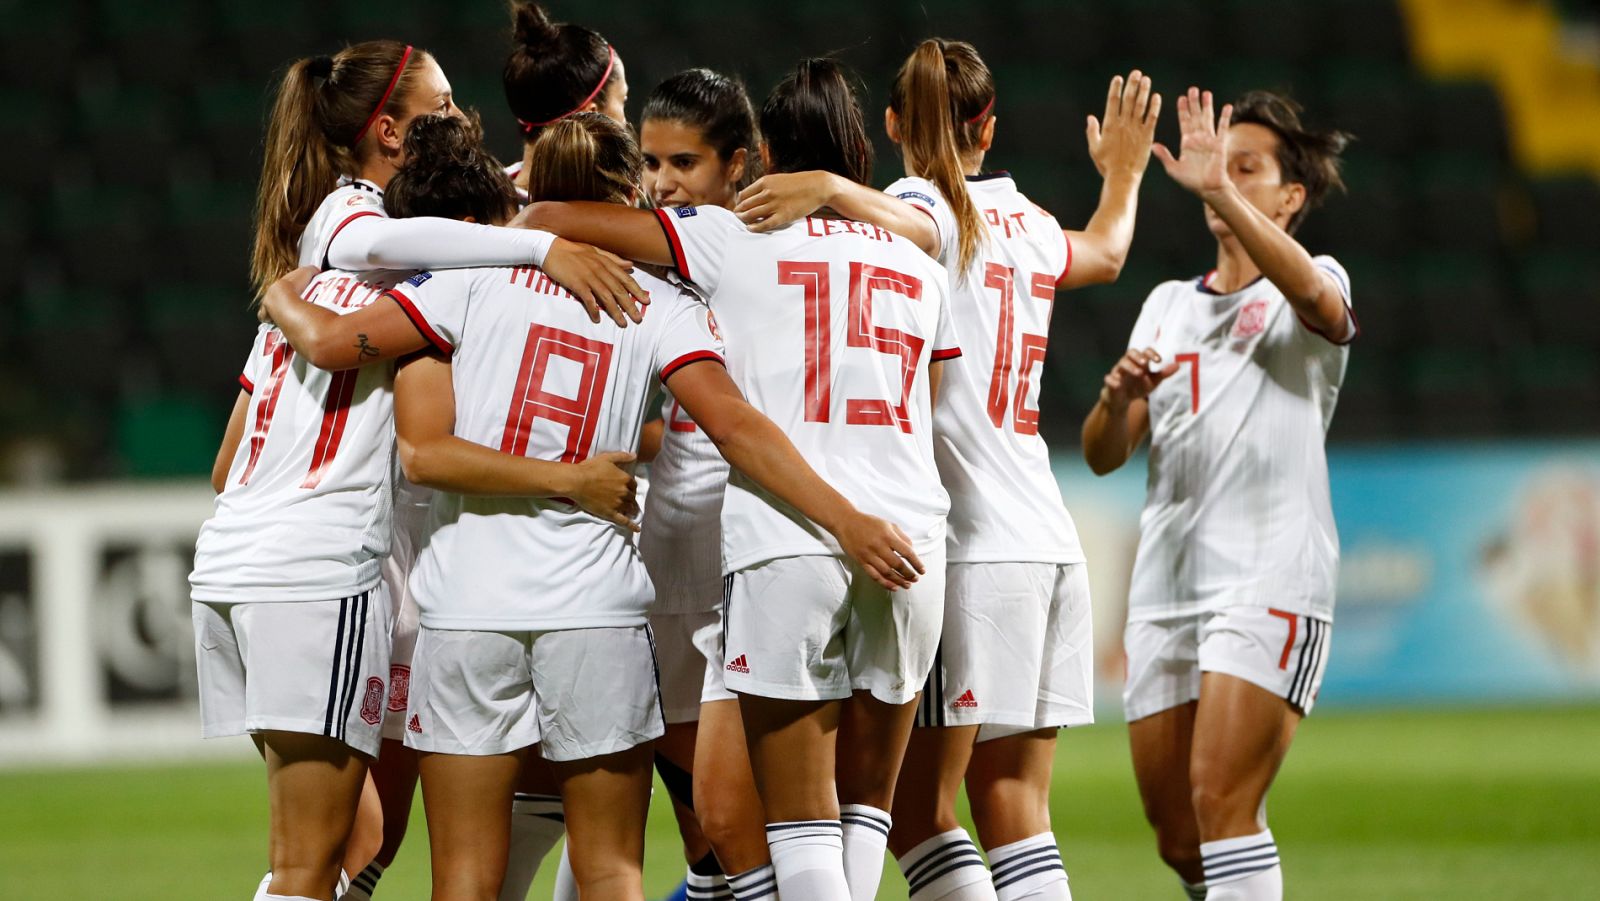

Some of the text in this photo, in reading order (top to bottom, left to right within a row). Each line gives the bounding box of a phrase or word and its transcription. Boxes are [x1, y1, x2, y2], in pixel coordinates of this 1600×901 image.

[777, 260, 926, 434] 15
[984, 261, 1057, 436] 12
[1174, 352, 1200, 416] 7
[726, 664, 750, 674] adidas
[1267, 607, 1298, 672] 7
